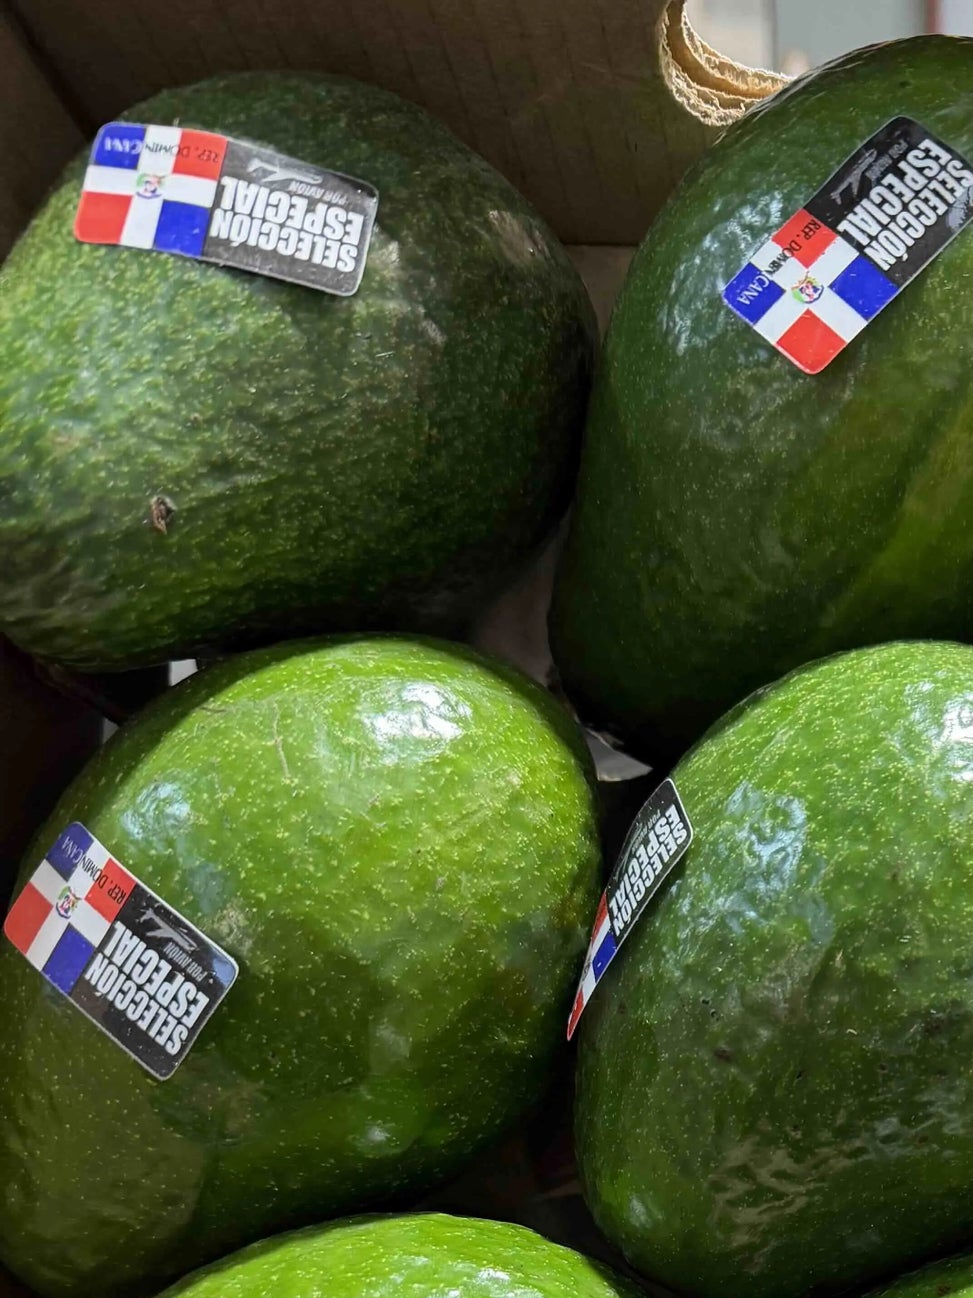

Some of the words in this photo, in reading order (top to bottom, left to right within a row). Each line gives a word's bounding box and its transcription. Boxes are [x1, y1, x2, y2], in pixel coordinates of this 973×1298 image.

[220, 176, 364, 243] ESPECIAL
[325, 190, 347, 205] POR
[837, 139, 952, 246] ESPECIAL
[211, 208, 358, 272] SELECCIÓN
[795, 219, 821, 241] REP.
[63, 836, 107, 889] DOMINICANA
[609, 804, 680, 911] ESPECIAL
[613, 823, 688, 936] SELECCIÓN
[107, 880, 127, 904] REP.
[85, 953, 188, 1055] SELECCIÓN
[106, 921, 209, 1028] ESPECIAL
[186, 962, 208, 982] POR
